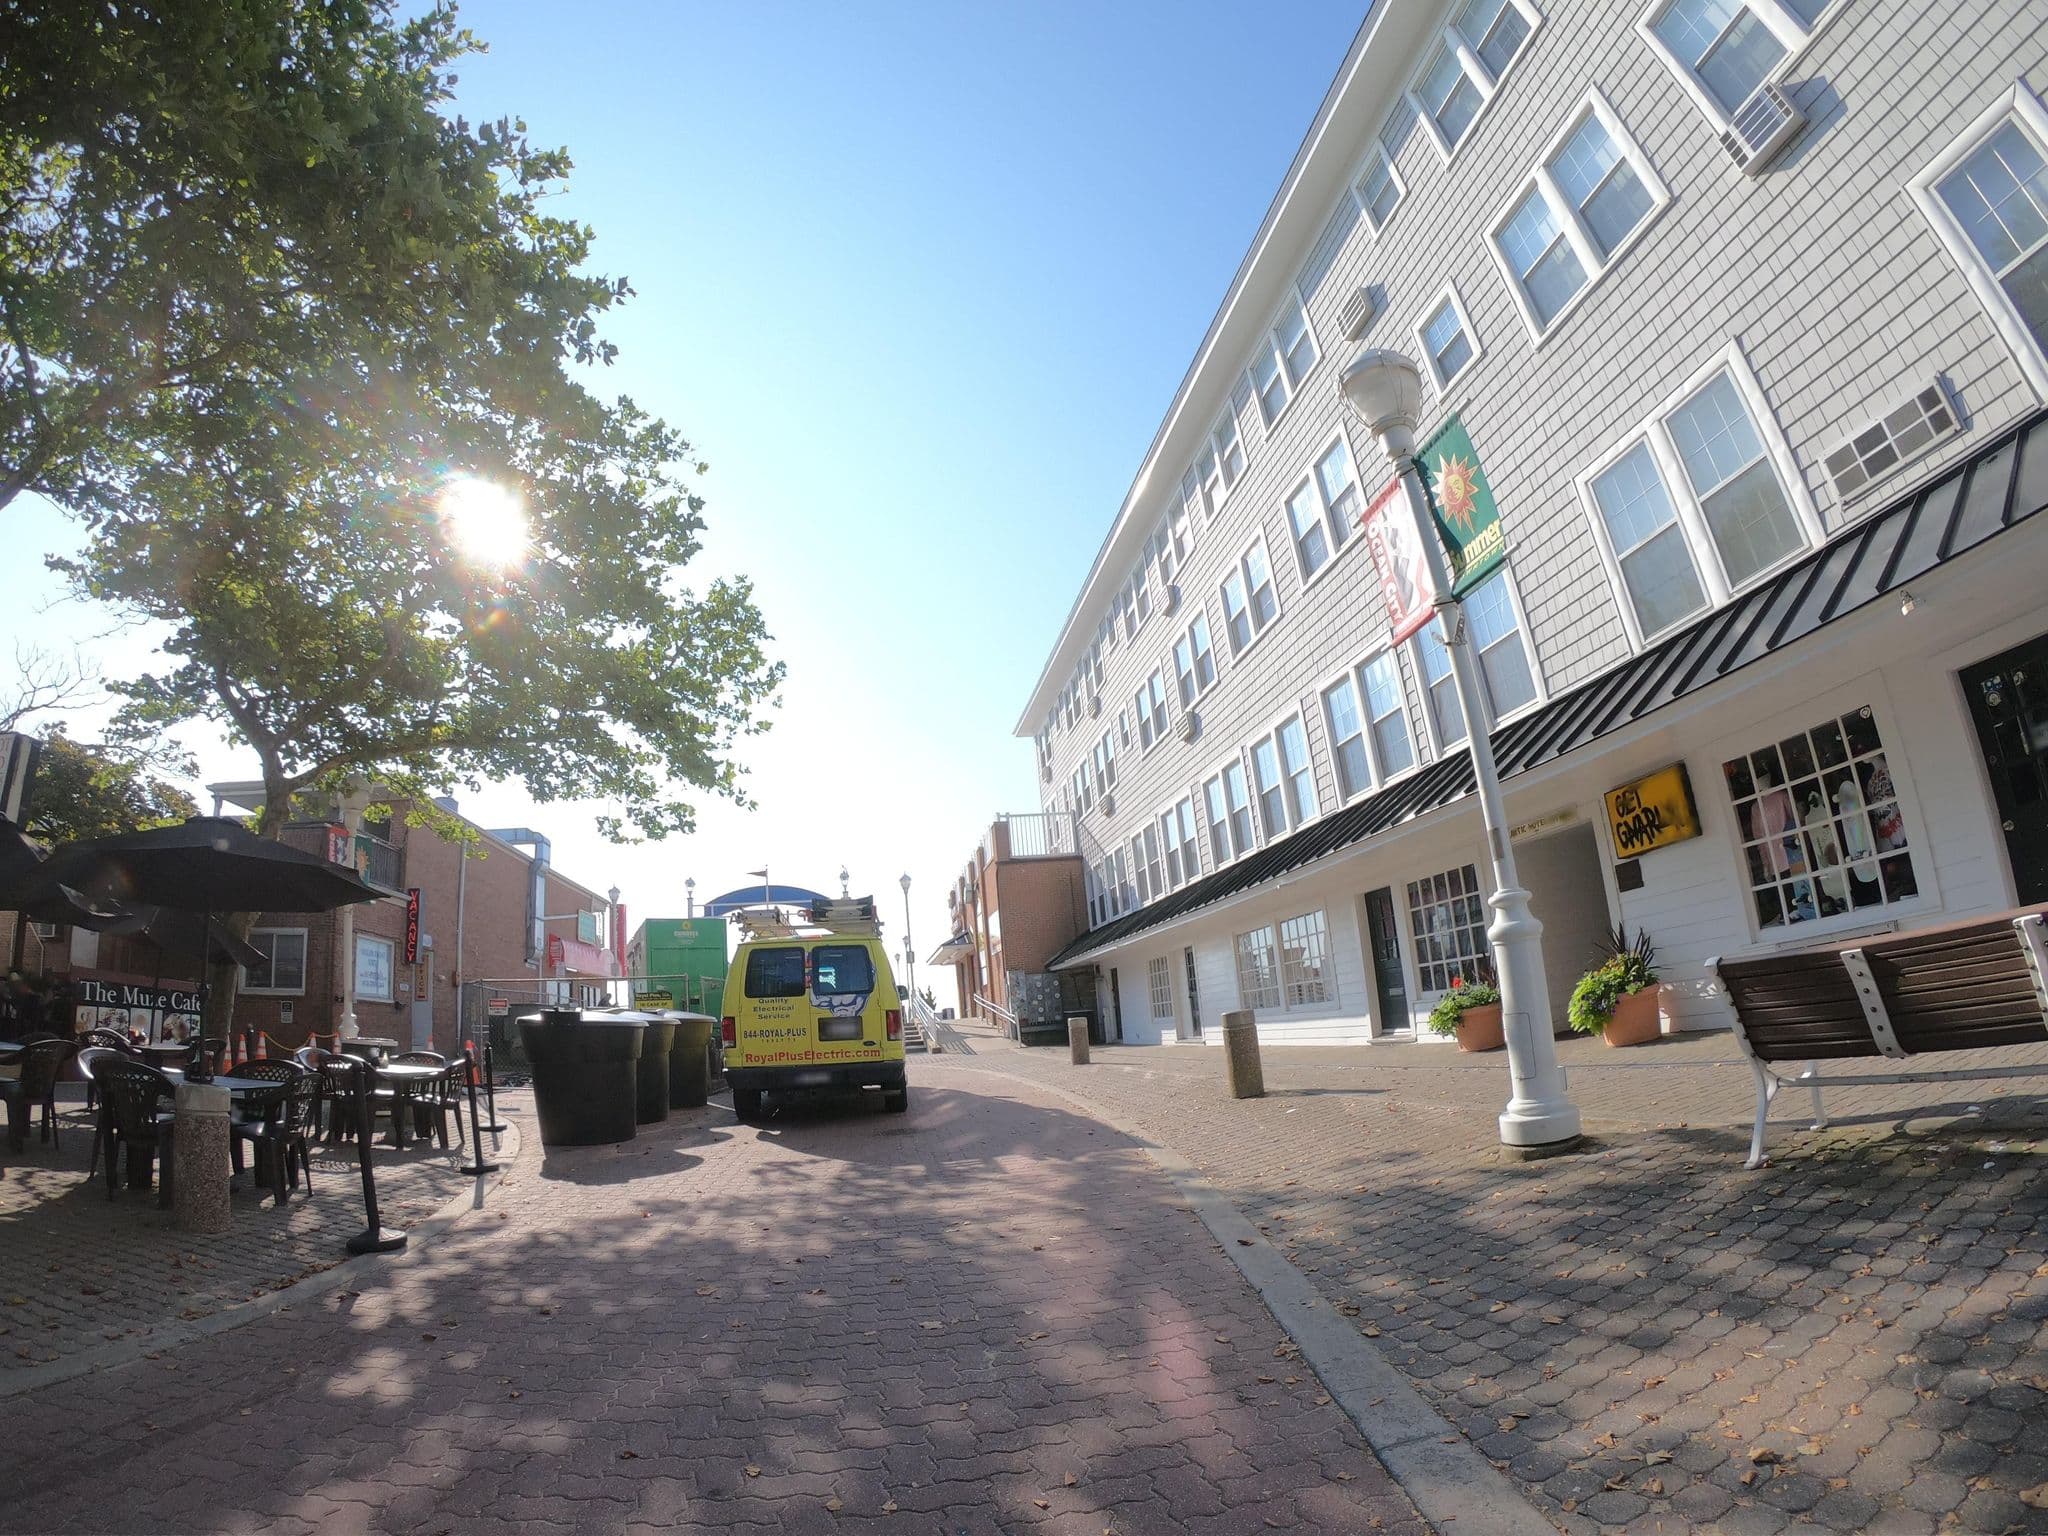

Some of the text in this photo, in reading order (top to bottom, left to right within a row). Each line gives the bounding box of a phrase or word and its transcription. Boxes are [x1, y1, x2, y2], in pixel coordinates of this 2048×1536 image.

[1614, 788, 1642, 818] GET
[408, 890, 419, 962] VACANCY
[80, 980, 117, 1004] The
[758, 997, 788, 1005] Quality
[757, 1012, 790, 1020] Service
[743, 1027, 807, 1039] 844-ROYAL-PLUS
[745, 1049, 881, 1064] RoyalPlusElectric.com
